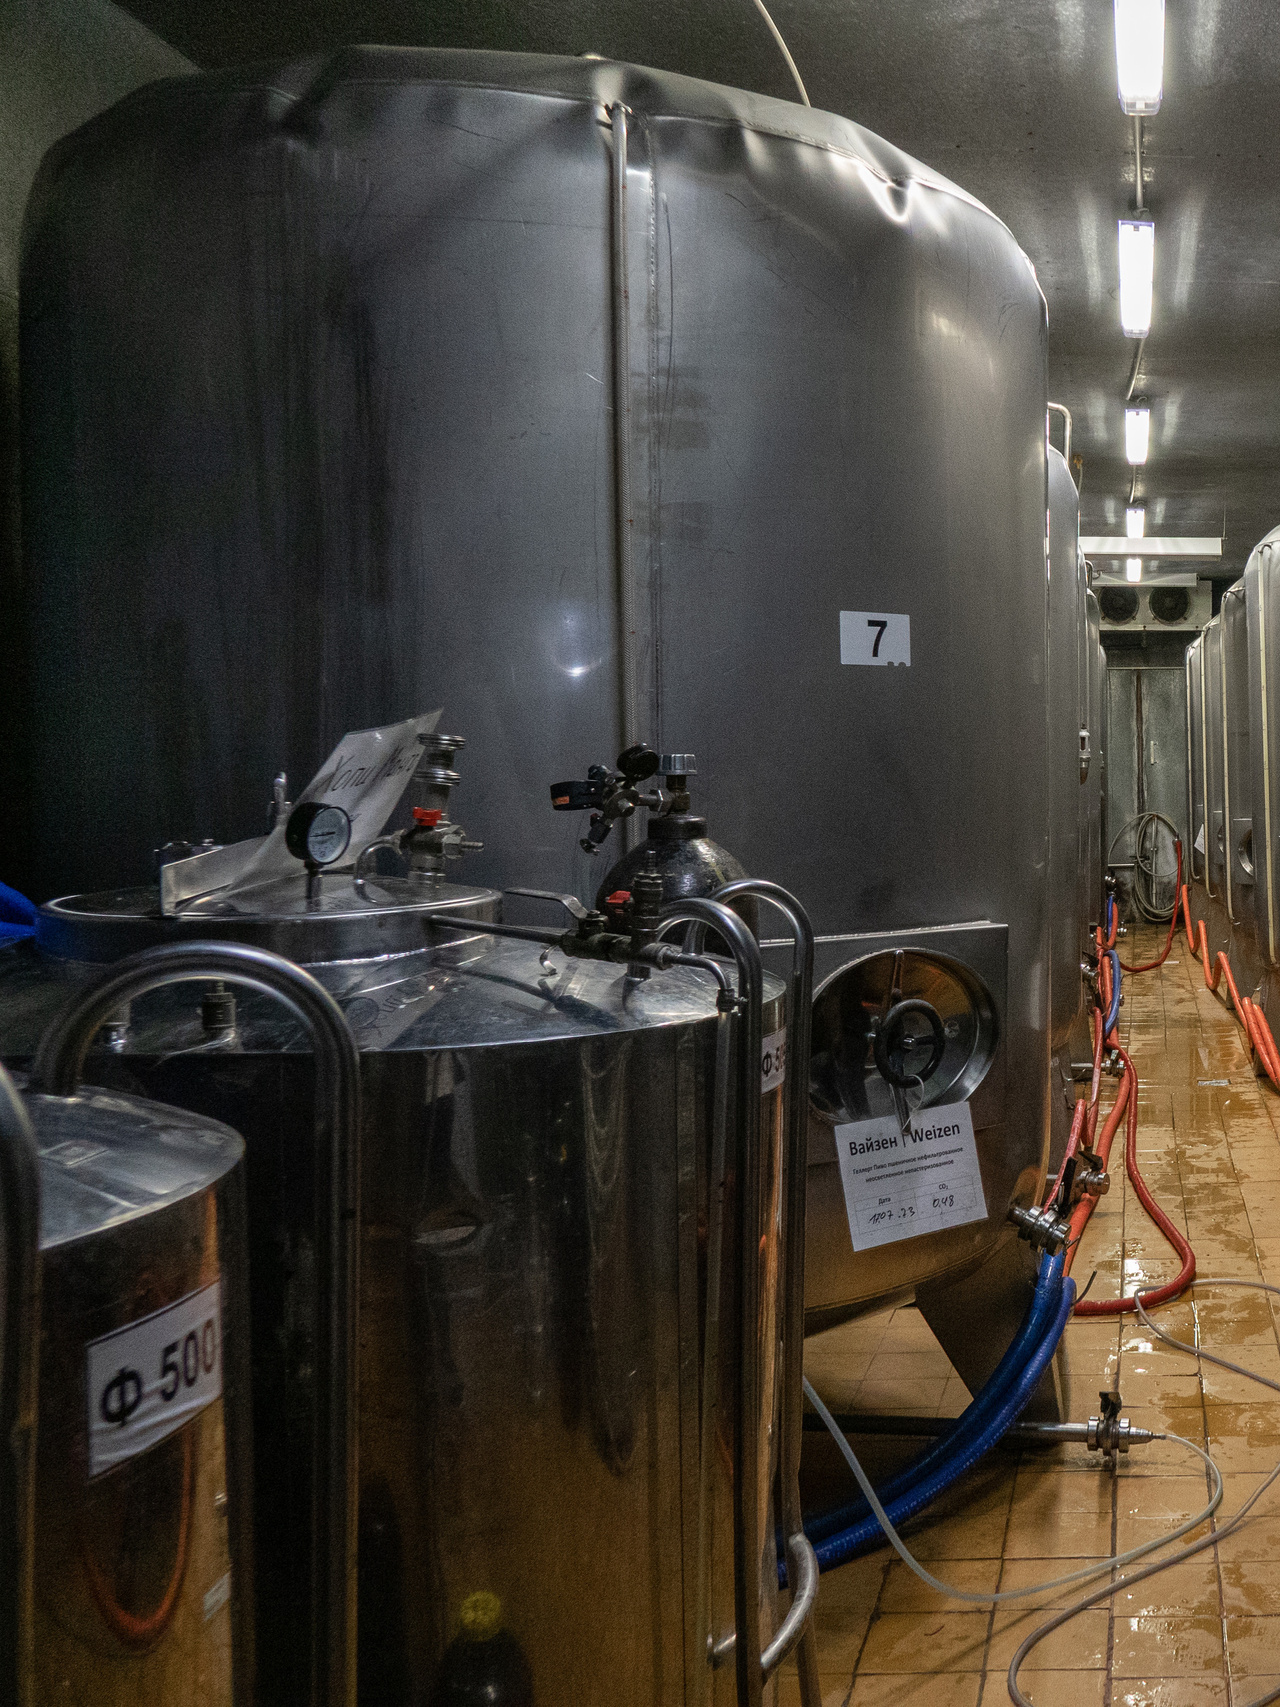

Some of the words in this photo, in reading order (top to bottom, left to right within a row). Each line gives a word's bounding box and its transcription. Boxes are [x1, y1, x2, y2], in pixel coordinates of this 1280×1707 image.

[868, 619, 888, 658] 7
[762, 1051, 773, 1077] Ф
[849, 1136, 898, 1156] Вайзен
[910, 1123, 961, 1144] Weizen
[873, 1162, 888, 1170] Пиво
[888, 1157, 917, 1168] пшеничное
[917, 1147, 963, 1161] нефильтрованное
[904, 1159, 954, 1174] непастеризованное
[878, 1197, 891, 1206] Дата
[100, 1364, 143, 1427] Ф
[160, 1317, 217, 1402] 500
